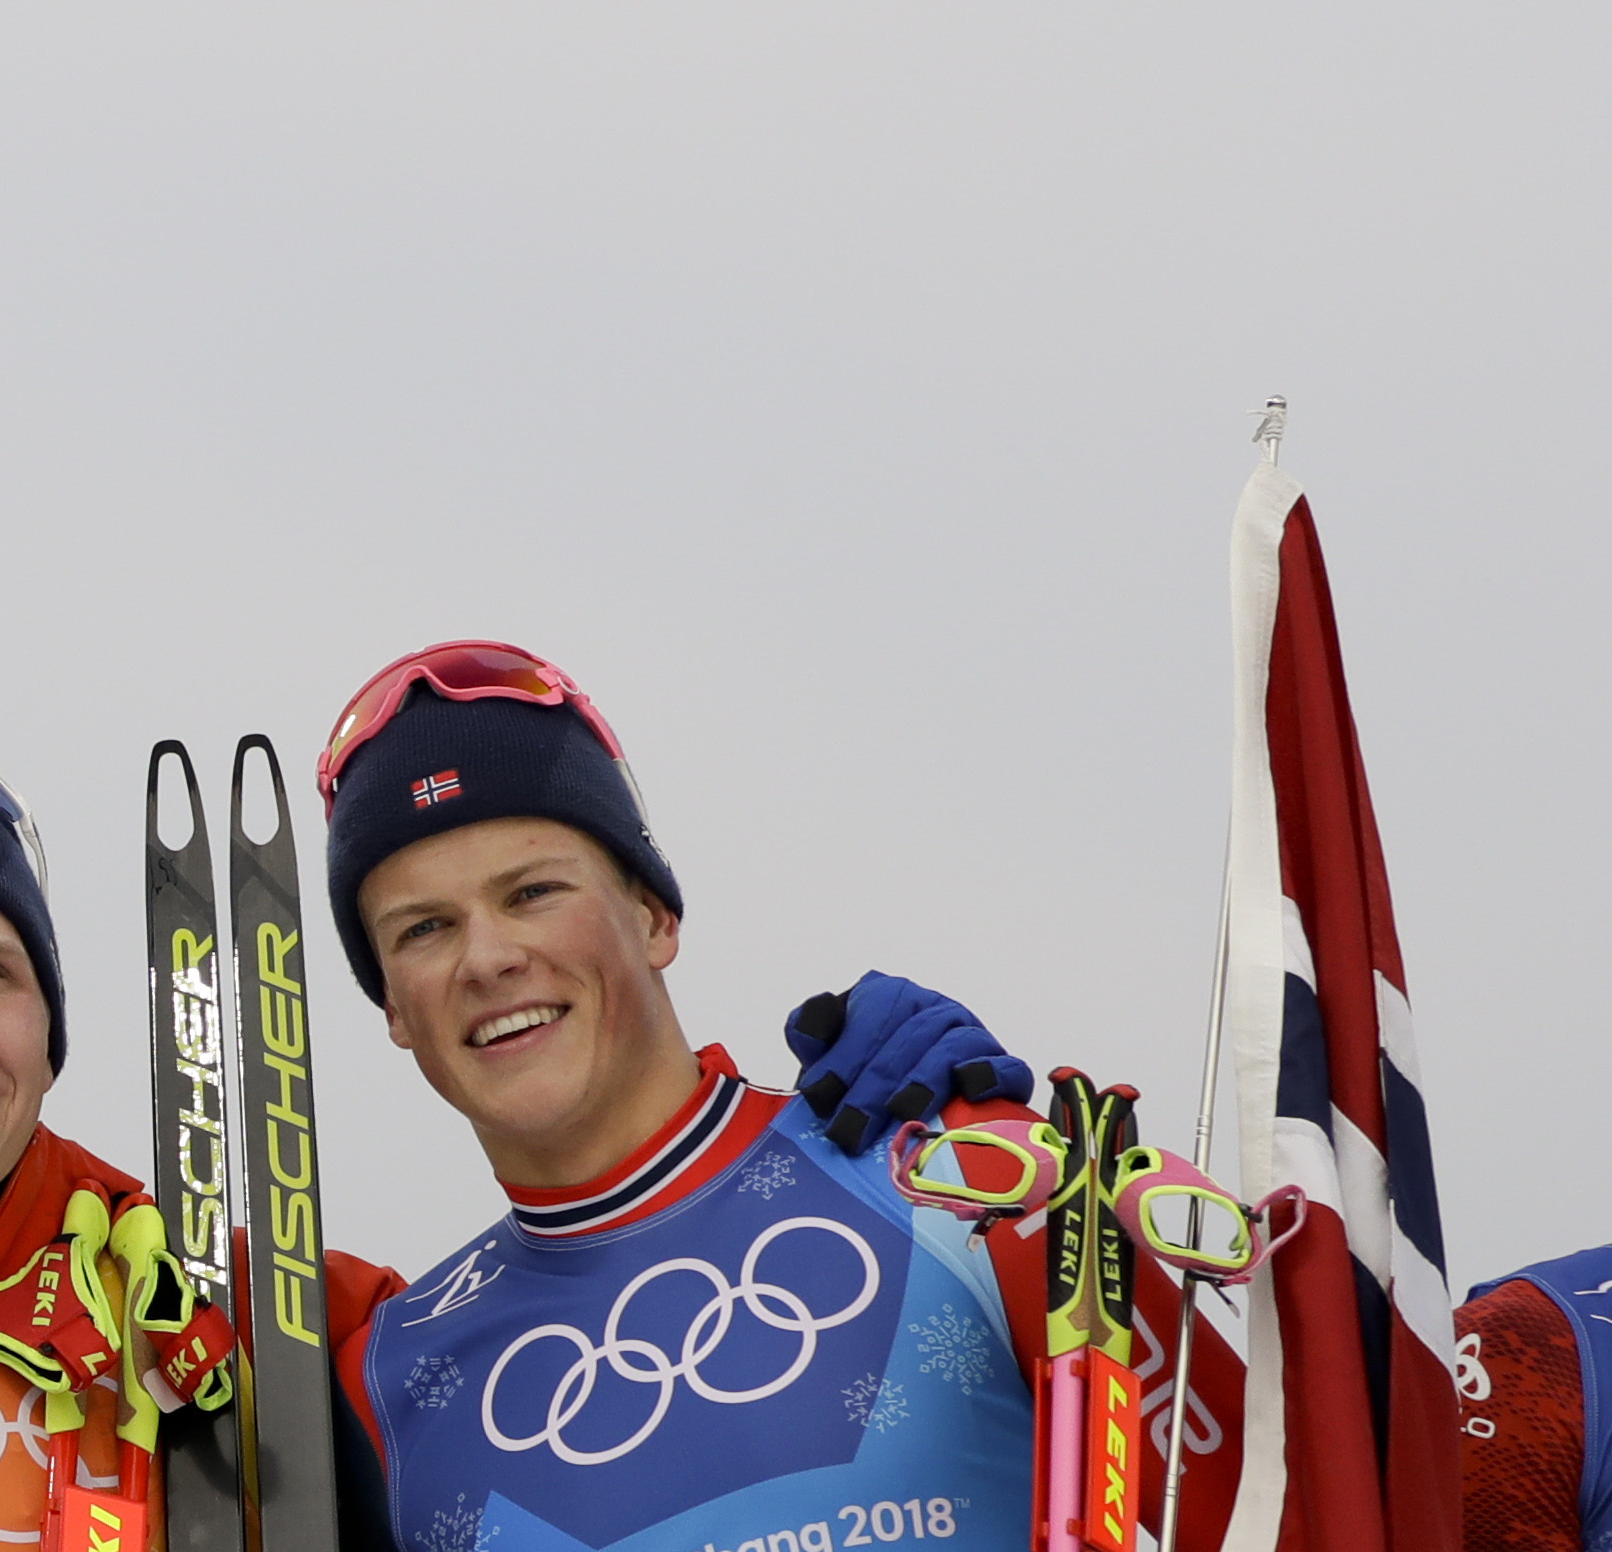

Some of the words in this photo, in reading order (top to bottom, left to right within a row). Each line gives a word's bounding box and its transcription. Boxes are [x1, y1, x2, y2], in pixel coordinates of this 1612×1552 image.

[258, 921, 321, 1348] FISCHER
[1059, 1211, 1082, 1285] LEKI
[1105, 1229, 1123, 1300] LEKI
[31, 1252, 63, 1326] LEKI
[162, 1338, 207, 1388] EKI
[1105, 1374, 1129, 1546] LEKI
[841, 1497, 957, 1548] 2018
